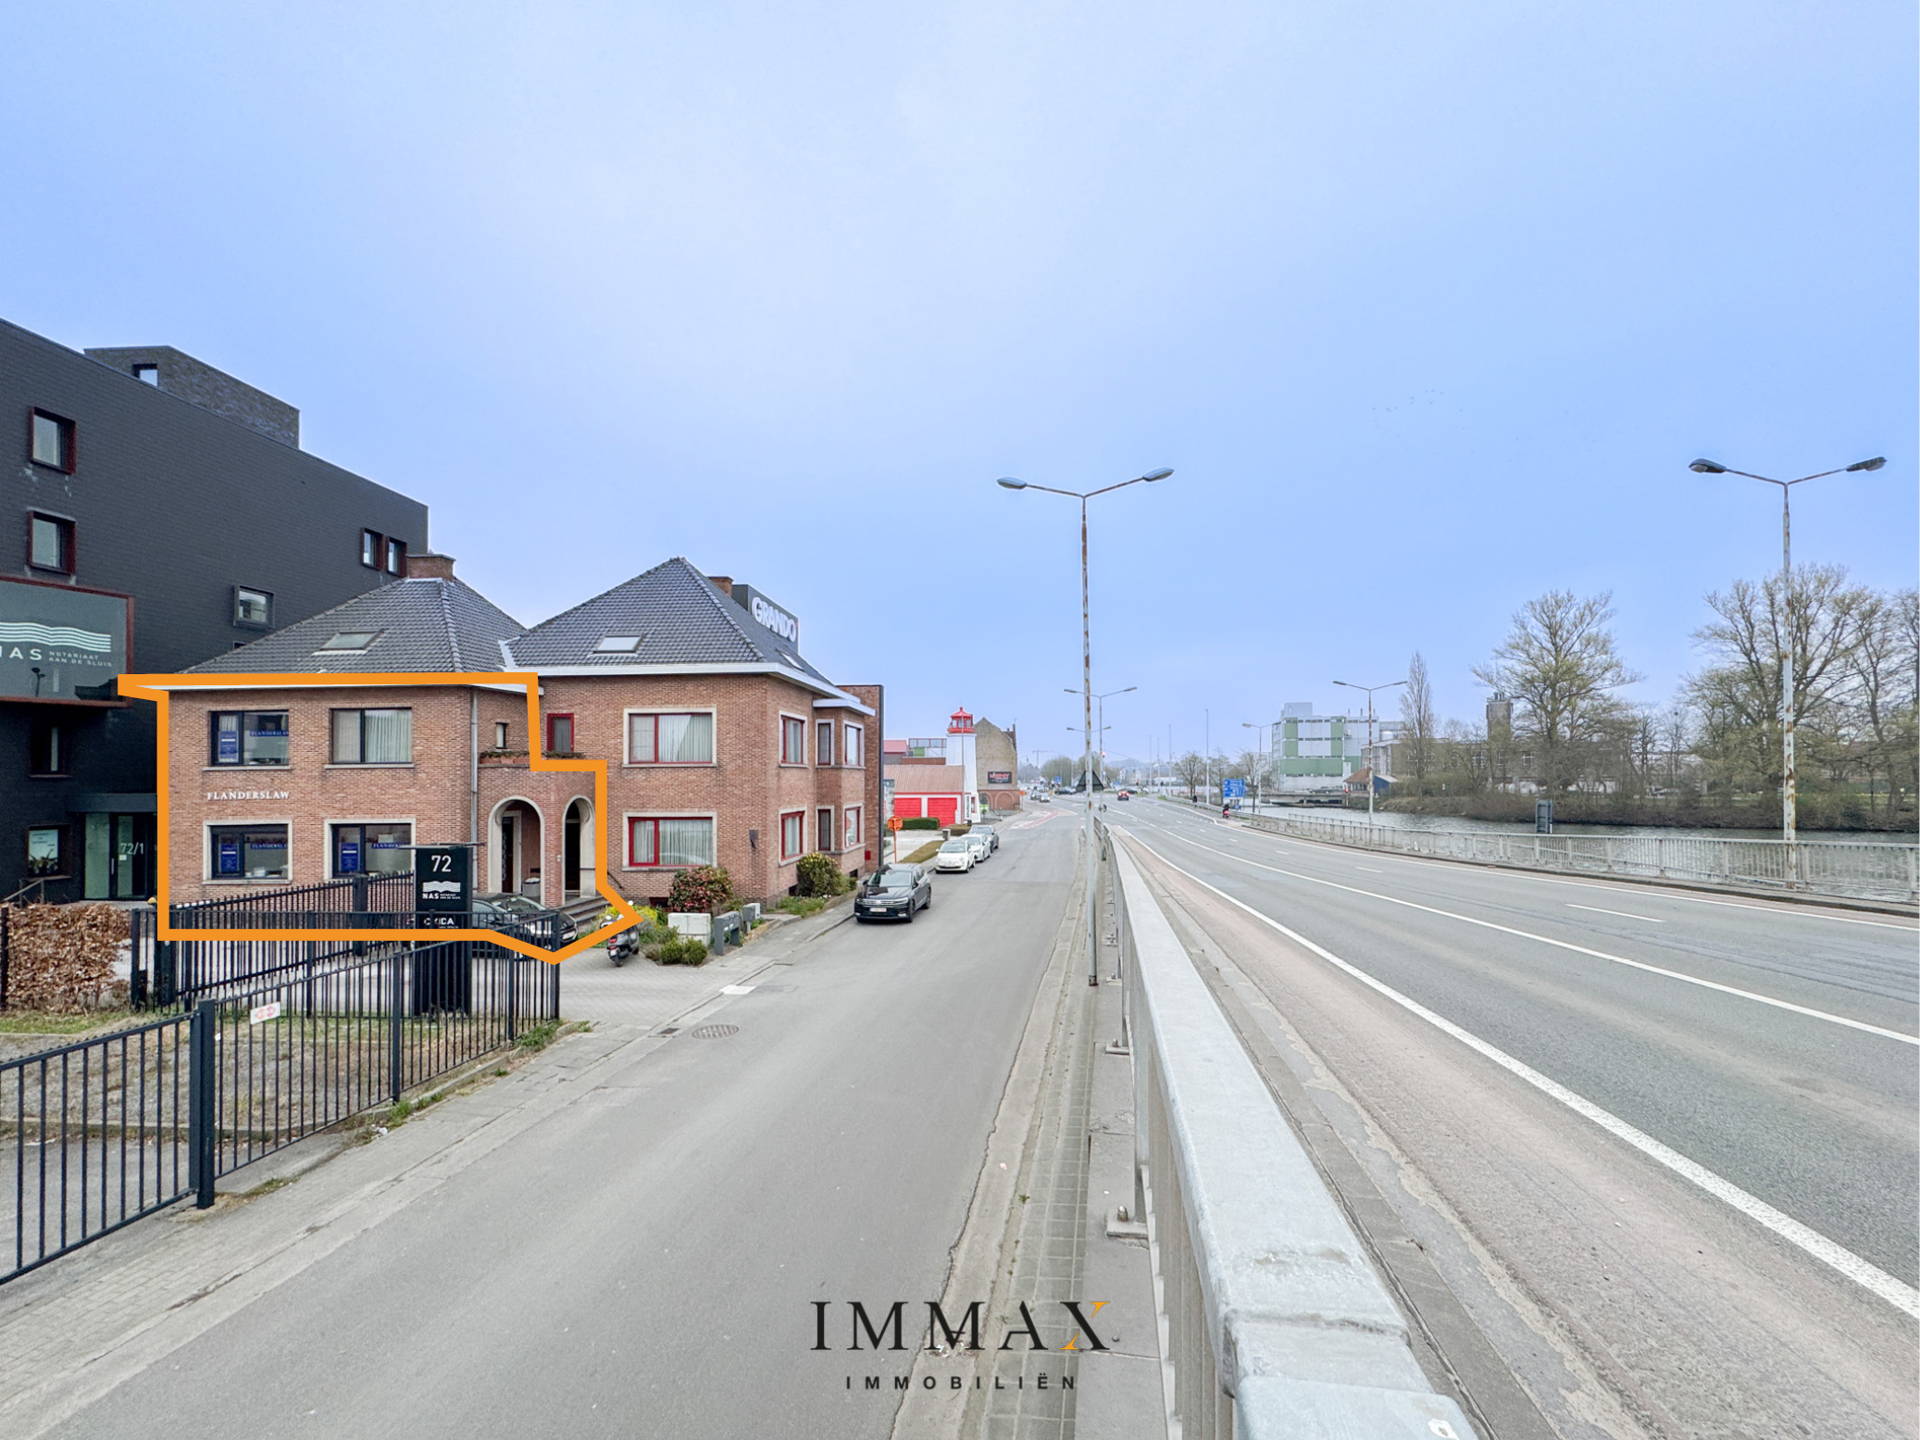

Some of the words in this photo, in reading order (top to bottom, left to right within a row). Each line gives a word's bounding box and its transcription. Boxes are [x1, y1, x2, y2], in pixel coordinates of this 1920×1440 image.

[752, 597, 796, 642] GRANDO
[0, 646, 42, 661] AS
[49, 651, 99, 660] NOTARIAAT
[207, 791, 290, 800] FLANDERSLAW
[120, 842, 144, 855] 72/1
[431, 855, 452, 872] 72
